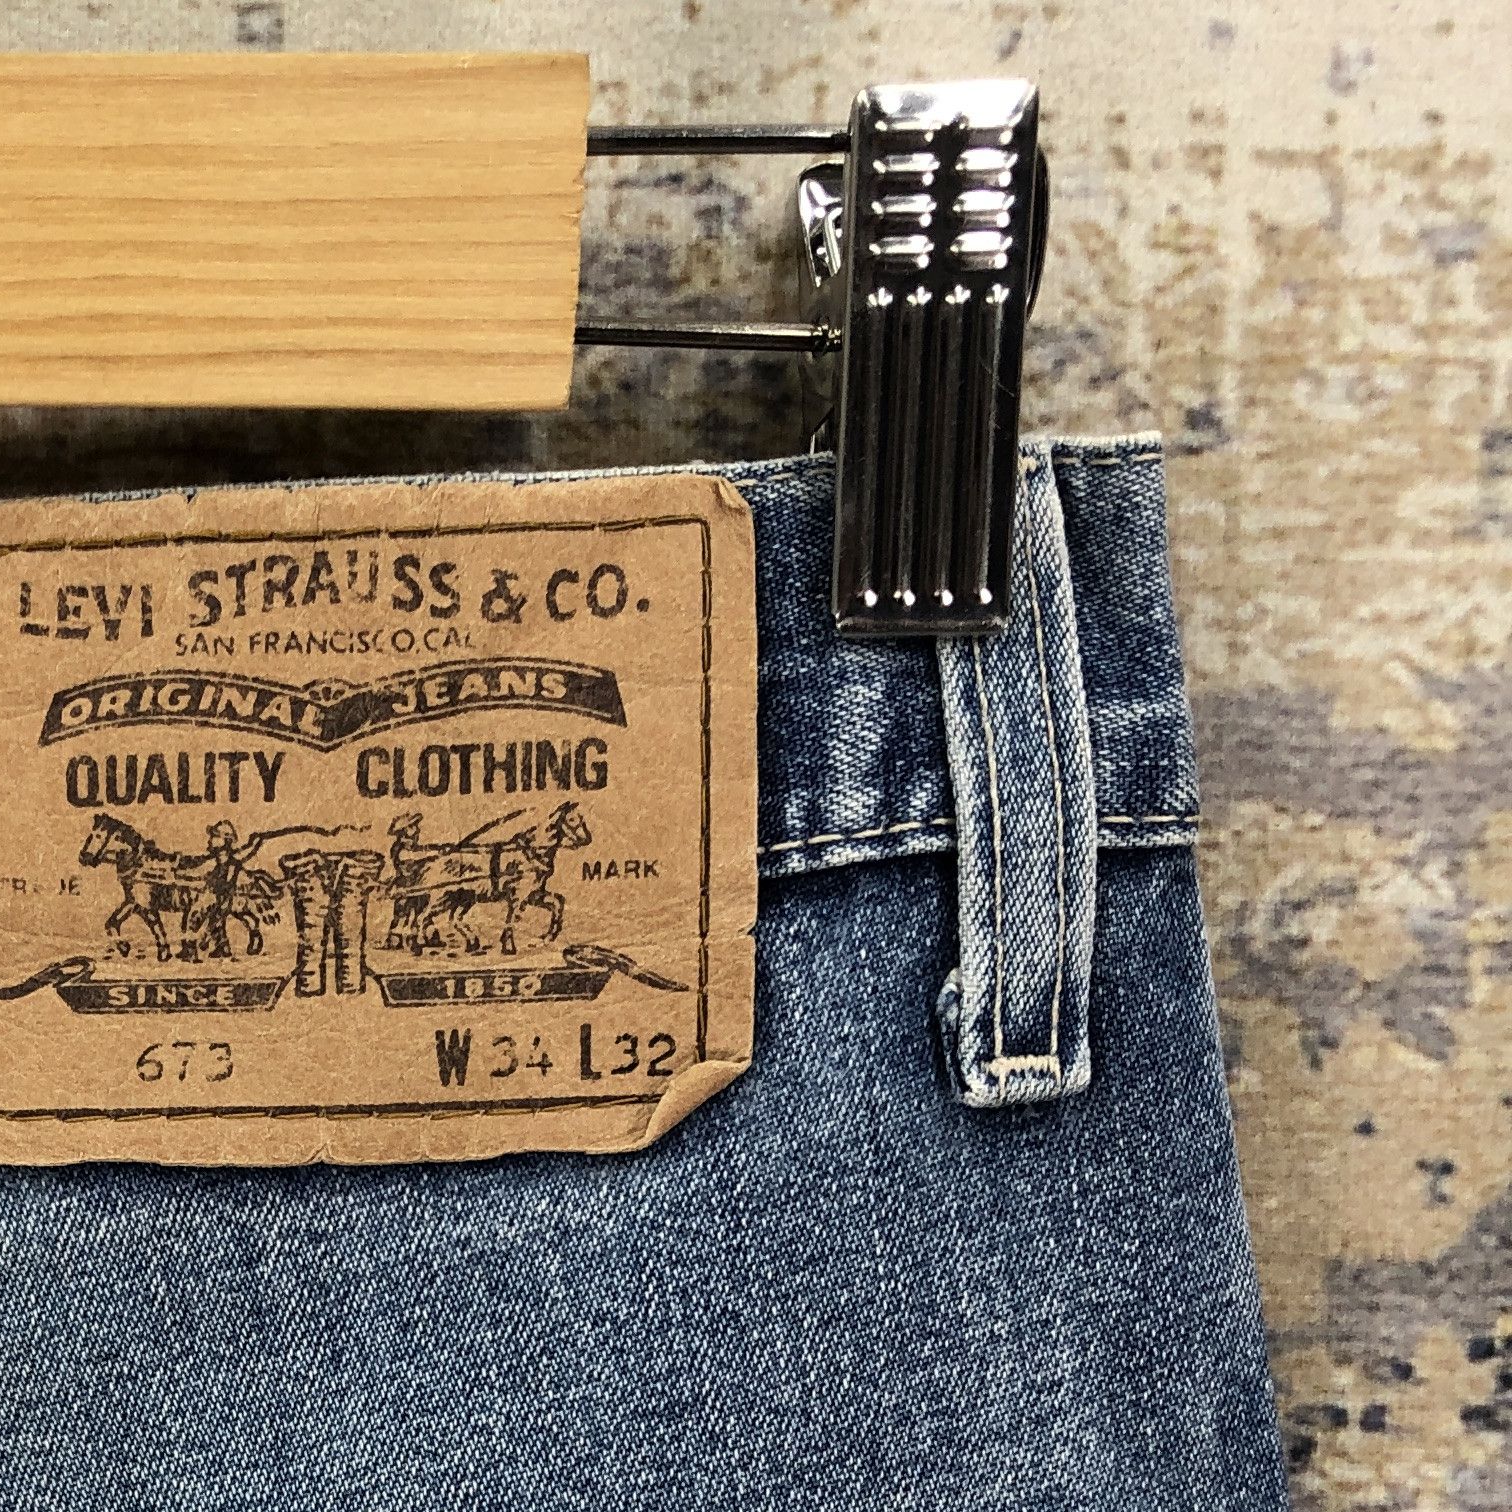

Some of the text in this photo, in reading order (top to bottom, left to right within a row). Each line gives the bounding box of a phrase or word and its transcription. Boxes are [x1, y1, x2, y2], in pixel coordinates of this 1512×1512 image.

[20, 549, 650, 642] LEVI STRAUSS & CO.
[175, 632, 236, 657] SAN
[60, 670, 569, 738] ORIGINAL JEANS
[65, 736, 609, 808] QUALITY CLOTHING
[581, 858, 660, 881] MARK
[107, 985, 235, 1007] SINCE
[135, 1041, 234, 1083] 673
